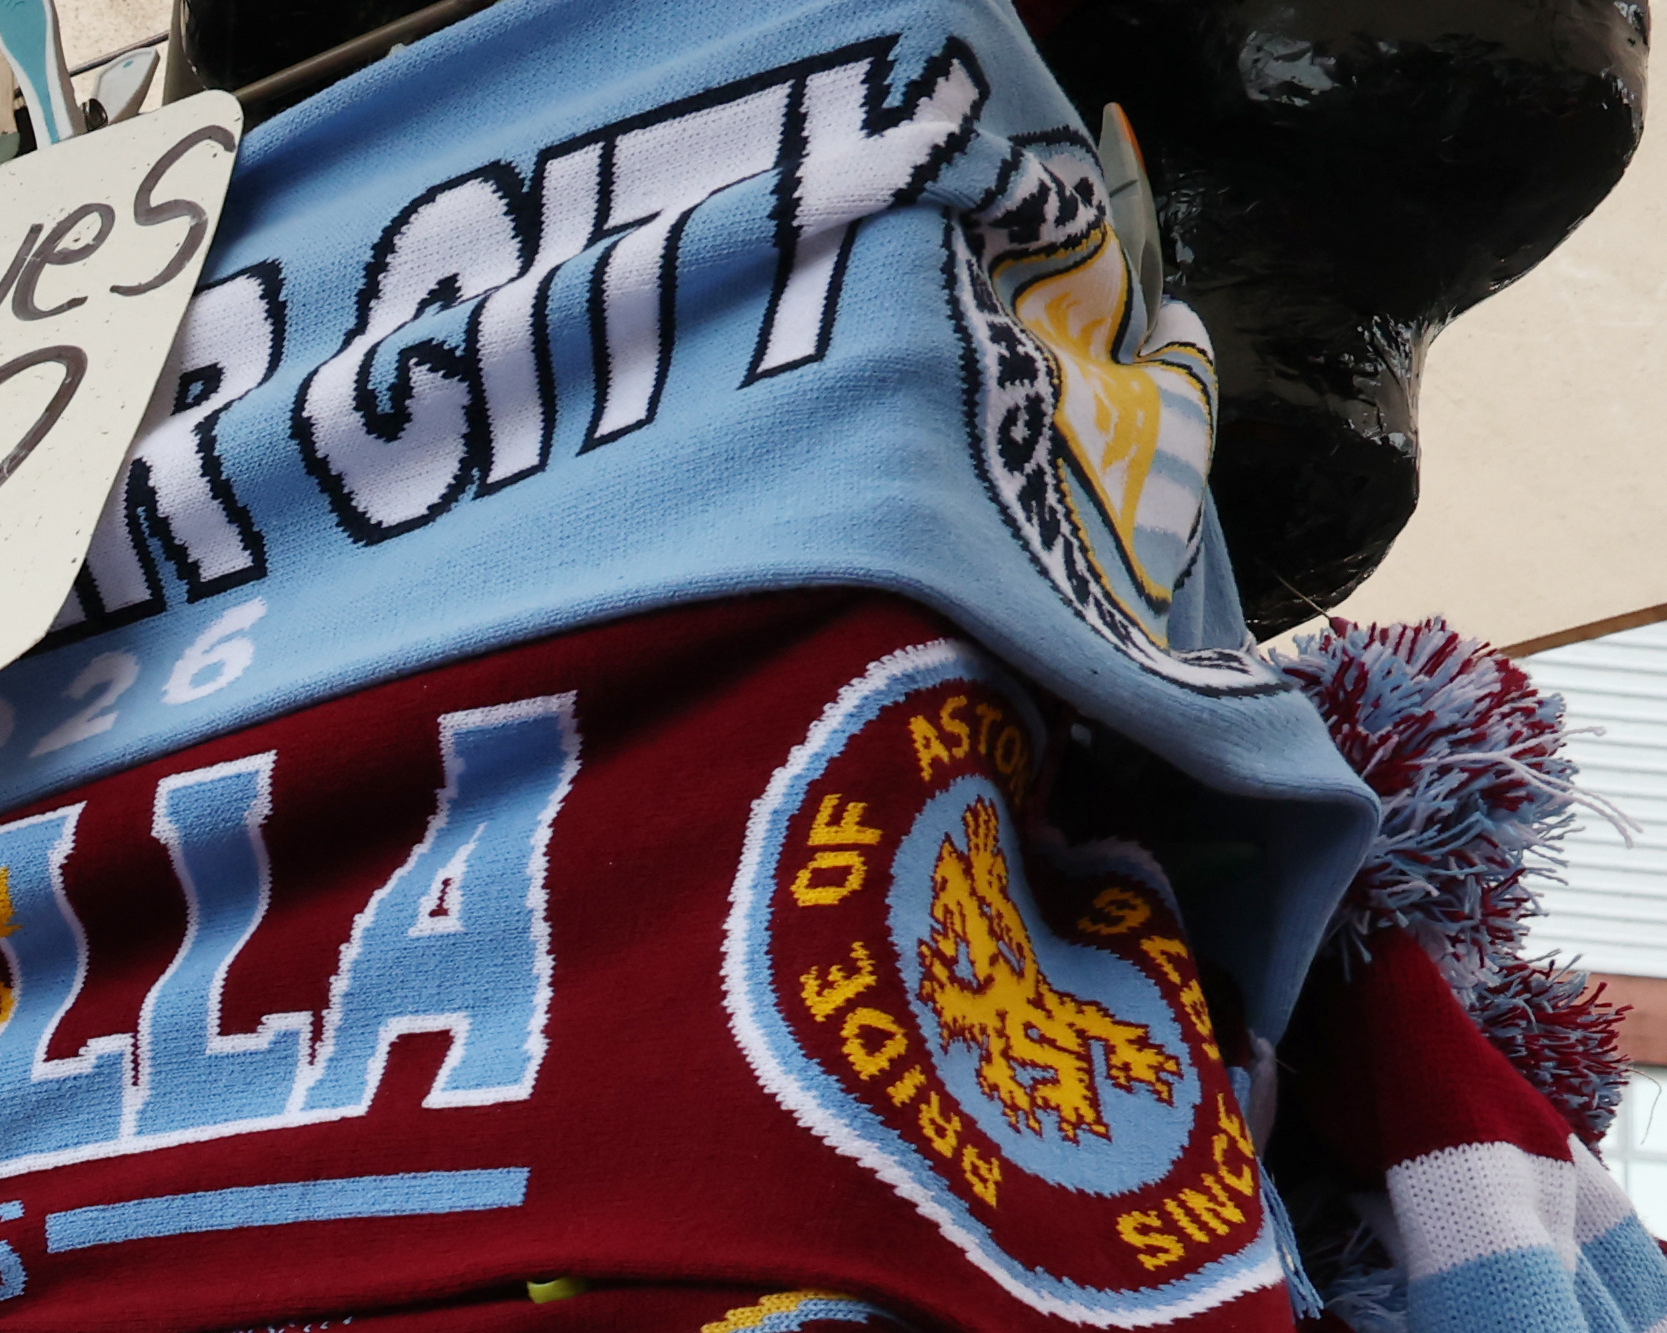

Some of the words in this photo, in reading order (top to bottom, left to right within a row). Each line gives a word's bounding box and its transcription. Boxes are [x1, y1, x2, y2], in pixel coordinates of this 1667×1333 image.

[290, 32, 993, 546] CITY
[791, 793, 883, 907] OF
[1116, 1092, 1257, 1271] SINCE
